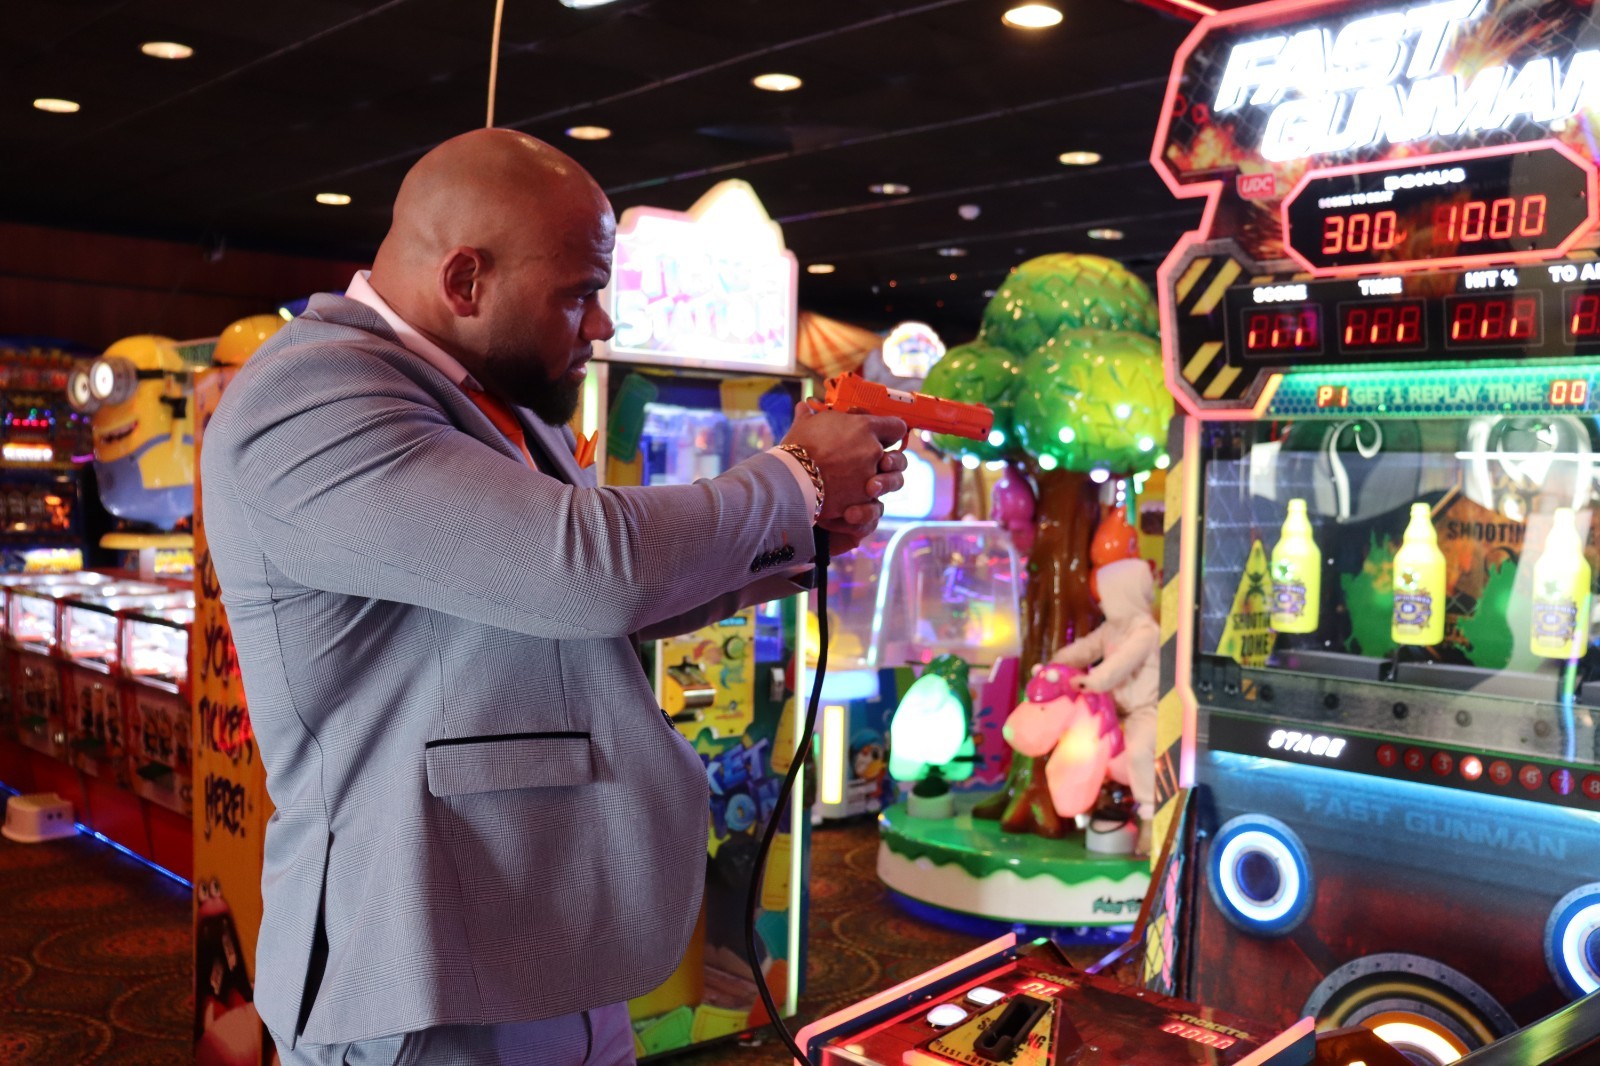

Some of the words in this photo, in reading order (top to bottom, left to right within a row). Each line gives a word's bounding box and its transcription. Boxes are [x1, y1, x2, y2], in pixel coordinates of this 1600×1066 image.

[1213, 0, 1487, 112] FAST
[1242, 176, 1272, 192] UDC
[1448, 194, 1547, 242] 1000
[1322, 210, 1397, 254] 300
[1464, 270, 1499, 288] HIT
[1500, 268, 1518, 287] %
[1548, 265, 1578, 283] TO
[1352, 386, 1386, 405] GET
[1408, 383, 1480, 404] REPLAY
[1551, 380, 1587, 405] 00
[1447, 520, 1527, 545] SHOOTIN
[1268, 729, 1347, 758] STAGE
[1409, 753, 1420, 767] 2
[1438, 756, 1449, 770] 3
[1495, 765, 1507, 780] 5
[1526, 770, 1538, 784] 6
[1589, 779, 1600, 794] 8
[1303, 790, 1391, 826] FAST
[1404, 810, 1568, 861] GUNMAN
[1037, 973, 1074, 987] COIN
[1162, 1024, 1235, 1050] 0000
[1180, 1014, 1249, 1039] TICKETS
